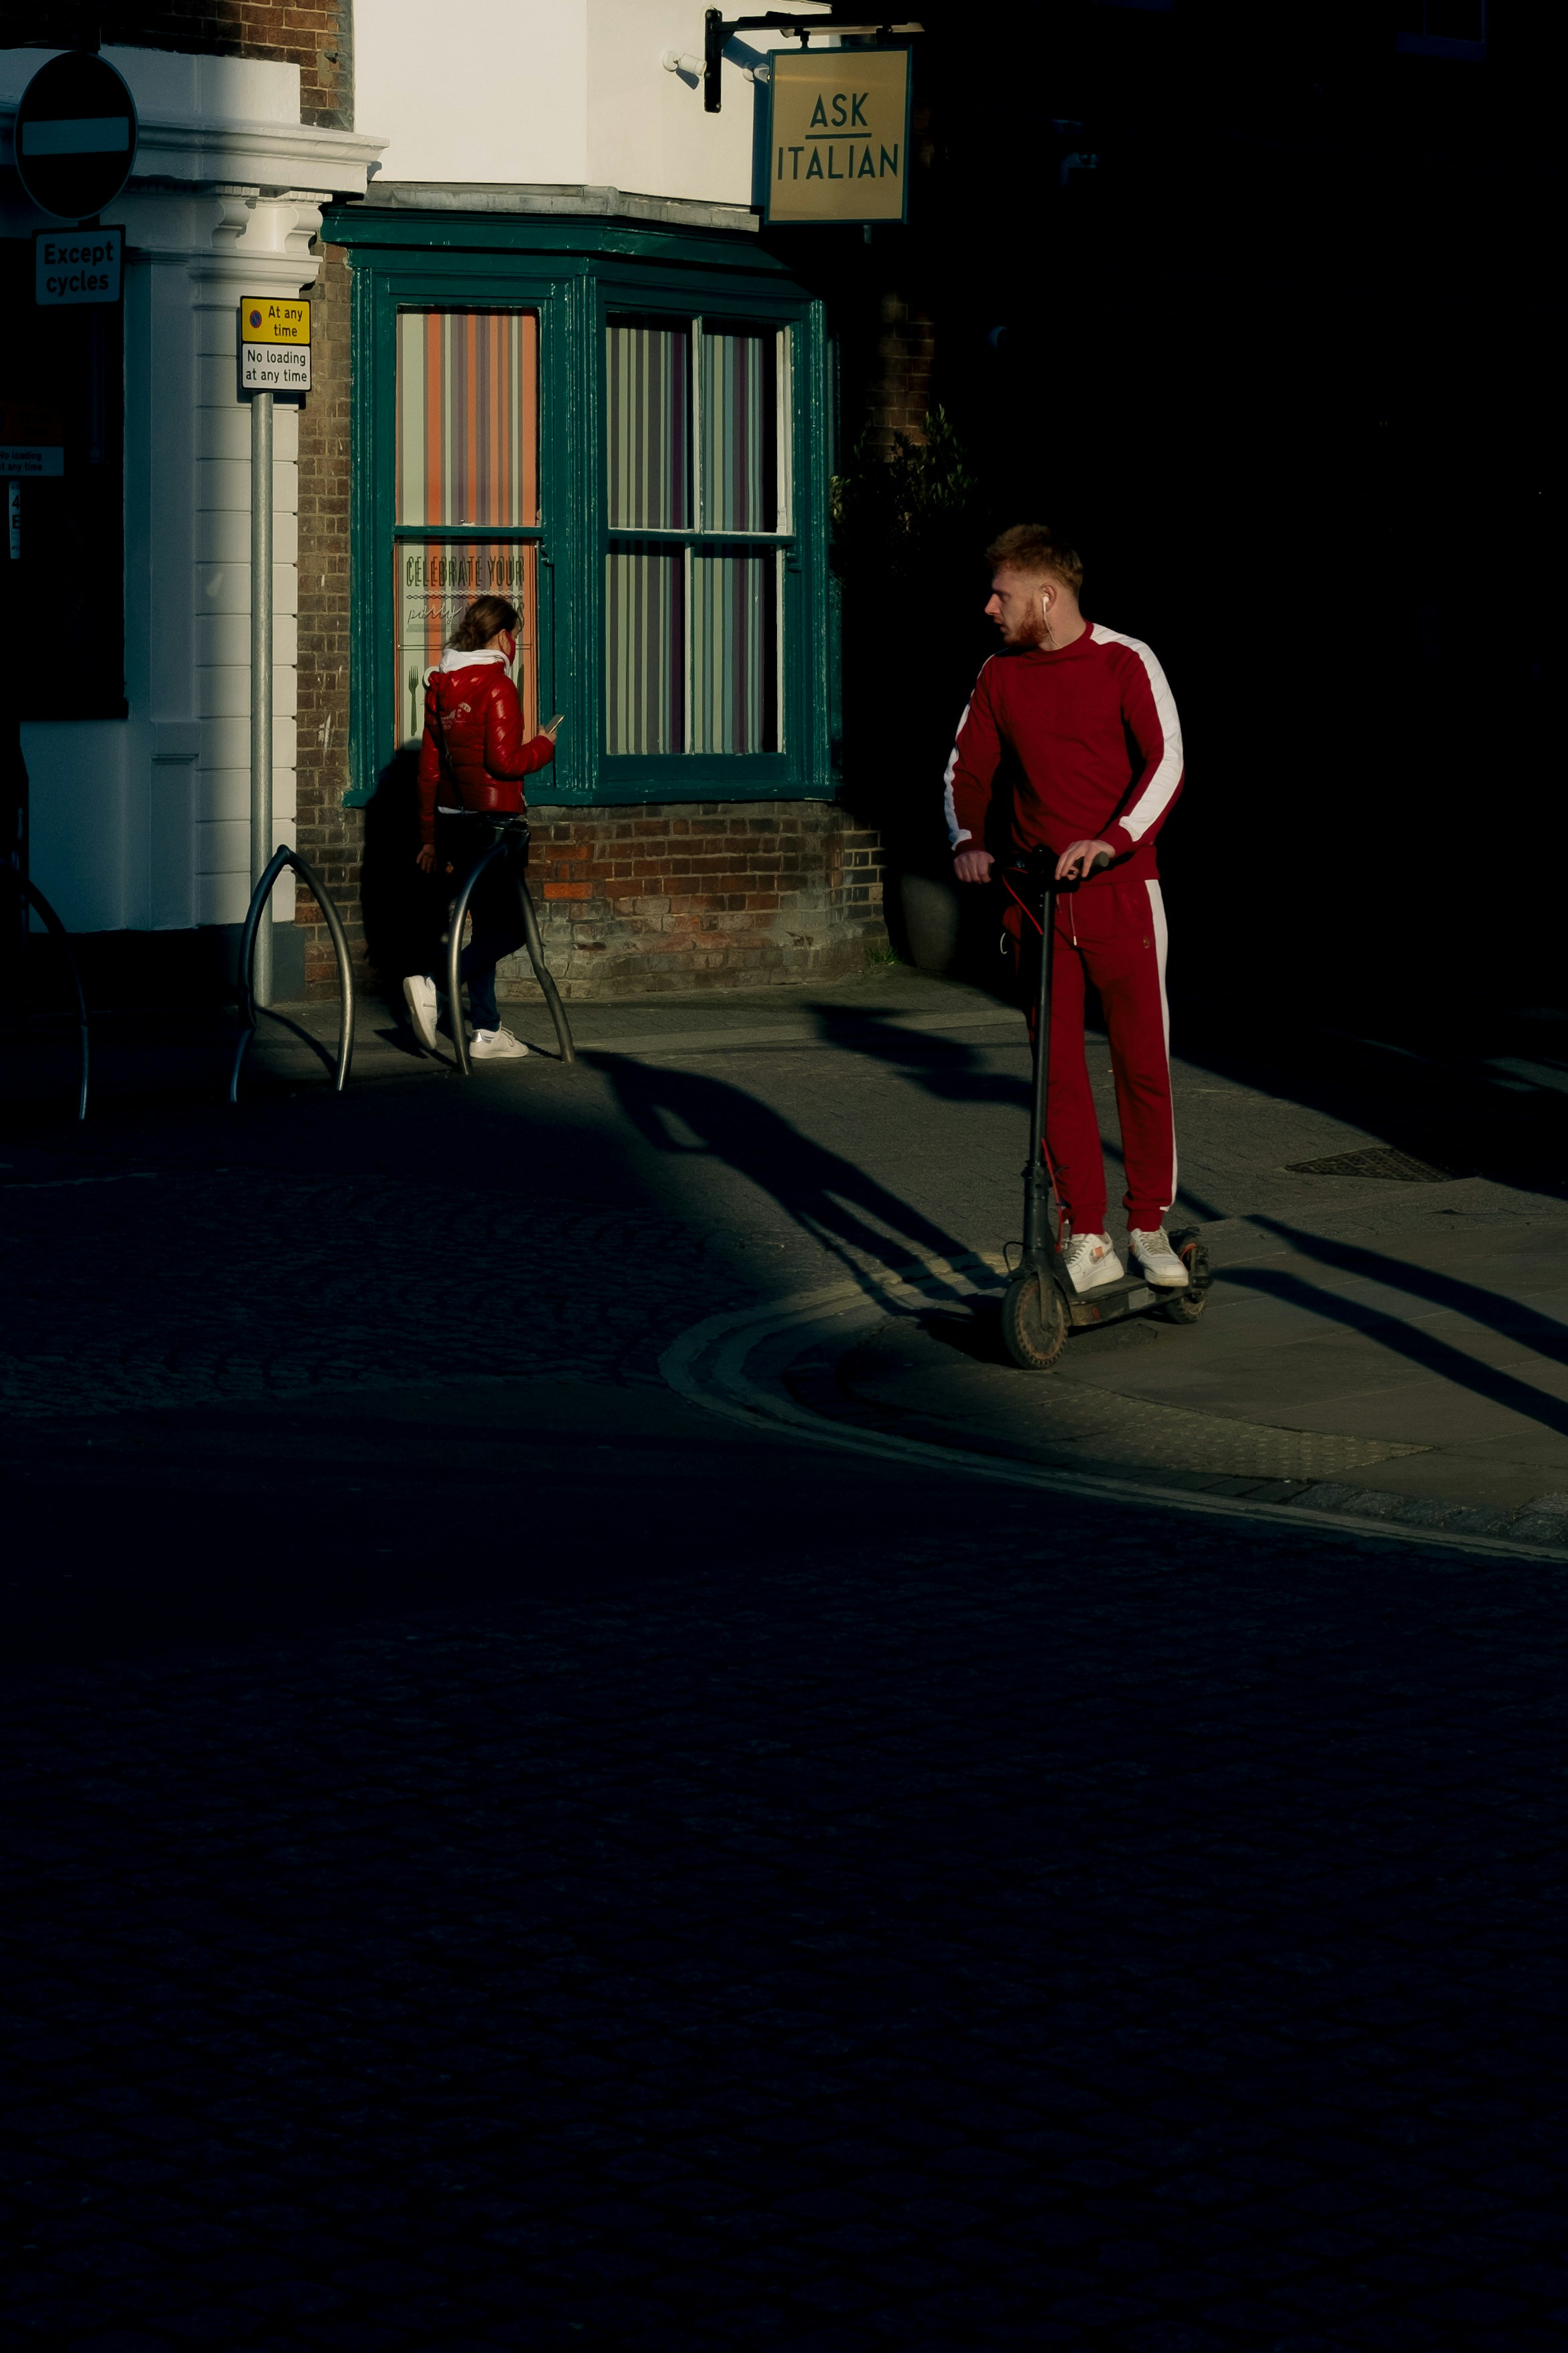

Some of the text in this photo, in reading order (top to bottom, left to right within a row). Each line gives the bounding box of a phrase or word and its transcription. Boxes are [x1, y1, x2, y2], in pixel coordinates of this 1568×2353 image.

[809, 92, 869, 128] ASK
[777, 142, 899, 180] ITALIAN
[44, 241, 114, 266] Except
[46, 269, 109, 296] cycles
[268, 305, 303, 321] At any
[273, 323, 298, 337] time
[247, 349, 306, 366] No loading
[245, 368, 307, 384] at any time
[12, 450, 42, 461] loading
[8, 464, 22, 472] any
[25, 462, 43, 471] time
[406, 556, 524, 587] CELEBRATE YOUR
